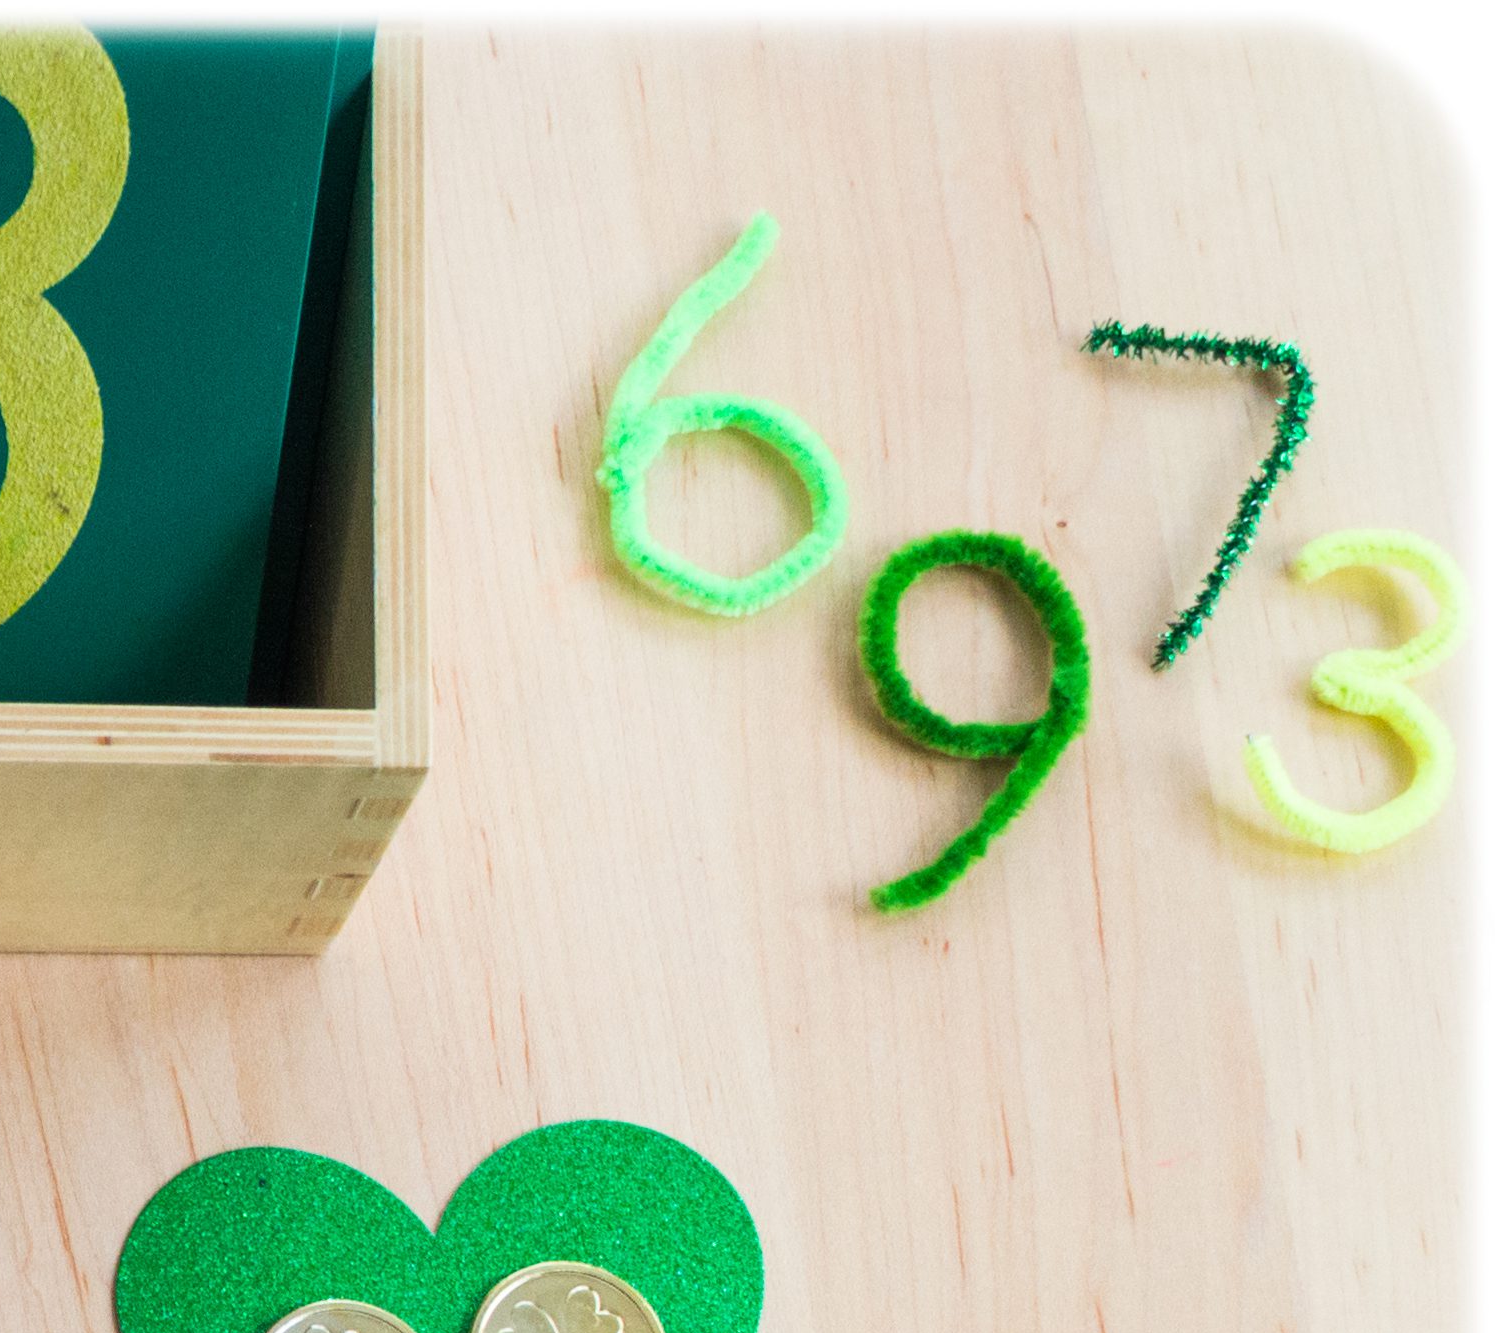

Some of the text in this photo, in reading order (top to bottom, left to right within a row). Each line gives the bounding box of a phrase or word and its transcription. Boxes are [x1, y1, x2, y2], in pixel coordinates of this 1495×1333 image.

[597, 210, 847, 616] 6
[1082, 318, 1315, 672] 7
[857, 530, 1091, 914] 9
[1243, 530, 1469, 852] 3
